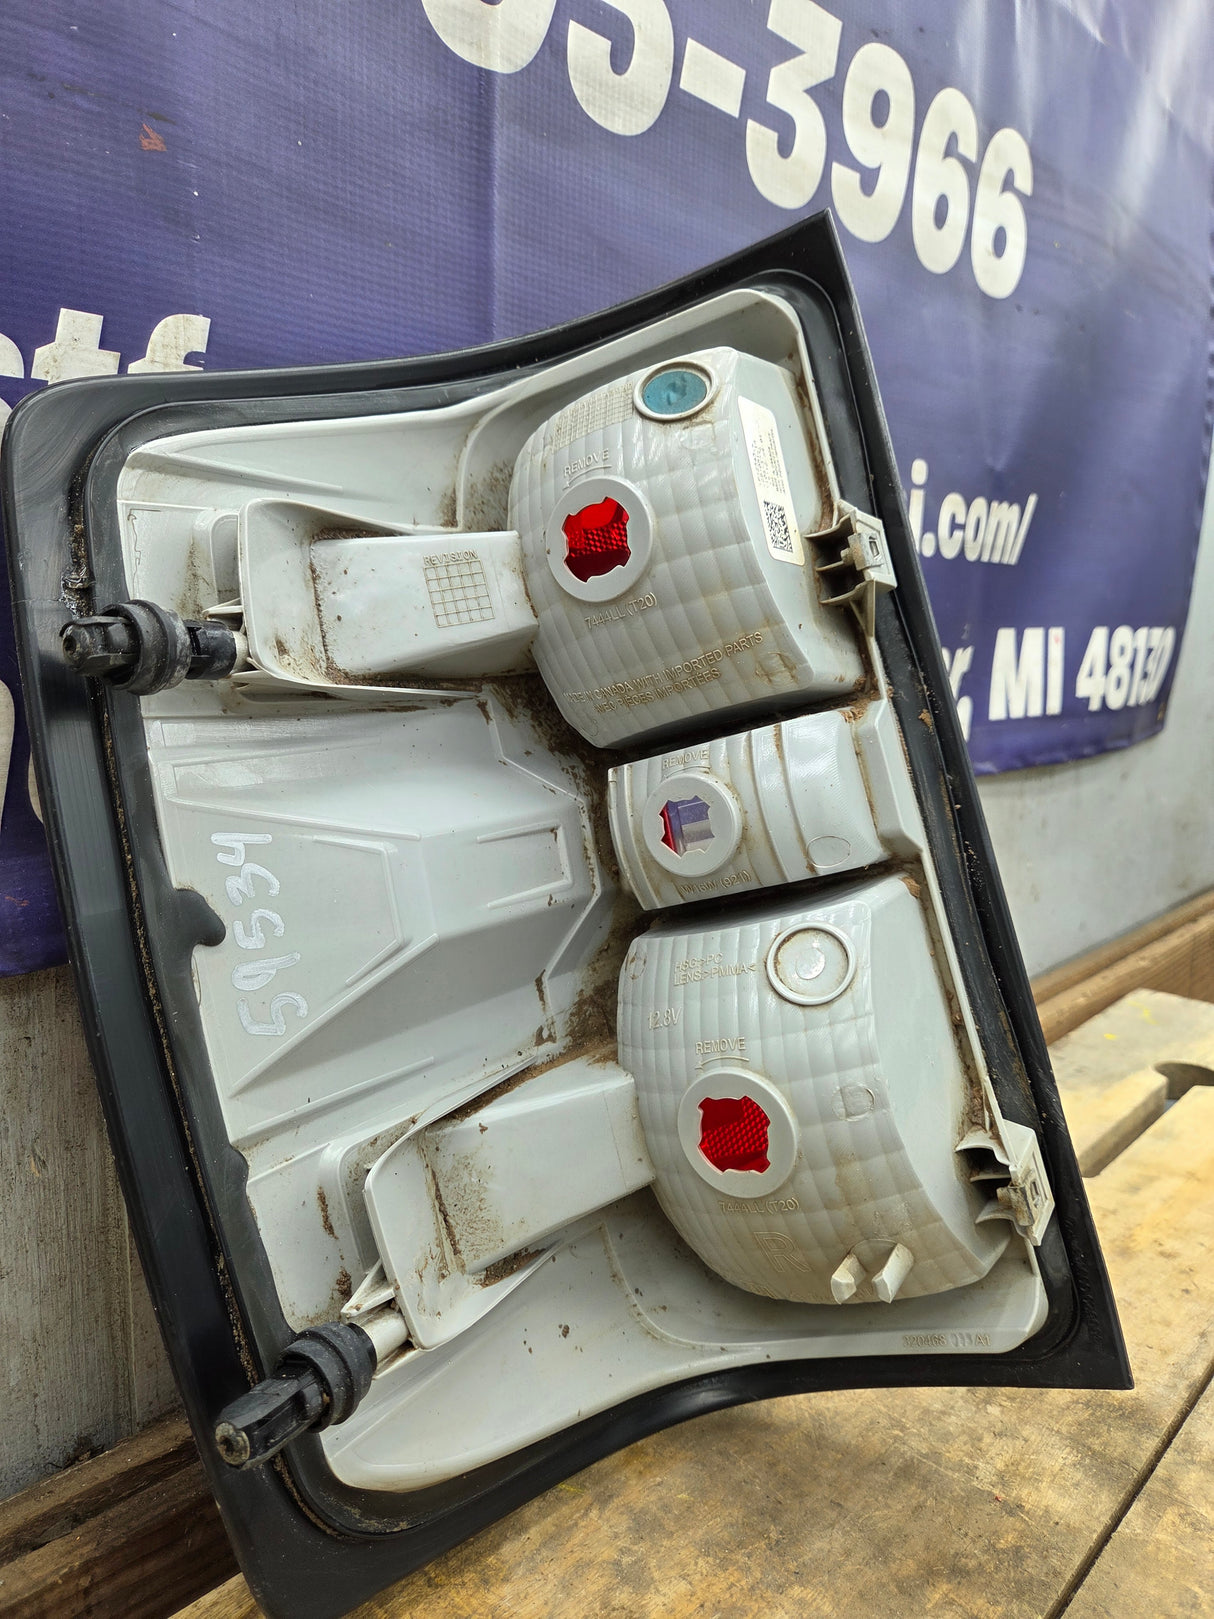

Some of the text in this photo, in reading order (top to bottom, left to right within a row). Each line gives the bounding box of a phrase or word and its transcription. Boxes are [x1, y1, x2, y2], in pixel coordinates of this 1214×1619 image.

[564, 449, 609, 477] REMOVE
[423, 549, 479, 566] REVISION
[626, 592, 658, 616] (T20)
[594, 681, 634, 700] CANADA
[633, 672, 663, 690] WITH
[662, 649, 723, 681] IMPORTED
[725, 631, 763, 657] PARTS
[988, 626, 1065, 721] MI
[1075, 624, 1176, 711] 48130
[654, 667, 721, 699] IMPORTÉES
[661, 749, 709, 769] REMOVE
[720, 870, 752, 889] (921)
[210, 832, 309, 1037] 59534
[648, 1007, 682, 1031] 12.8V
[695, 1036, 746, 1055] REMOVE
[765, 1197, 800, 1215] (T20)
[754, 1231, 812, 1273] R
